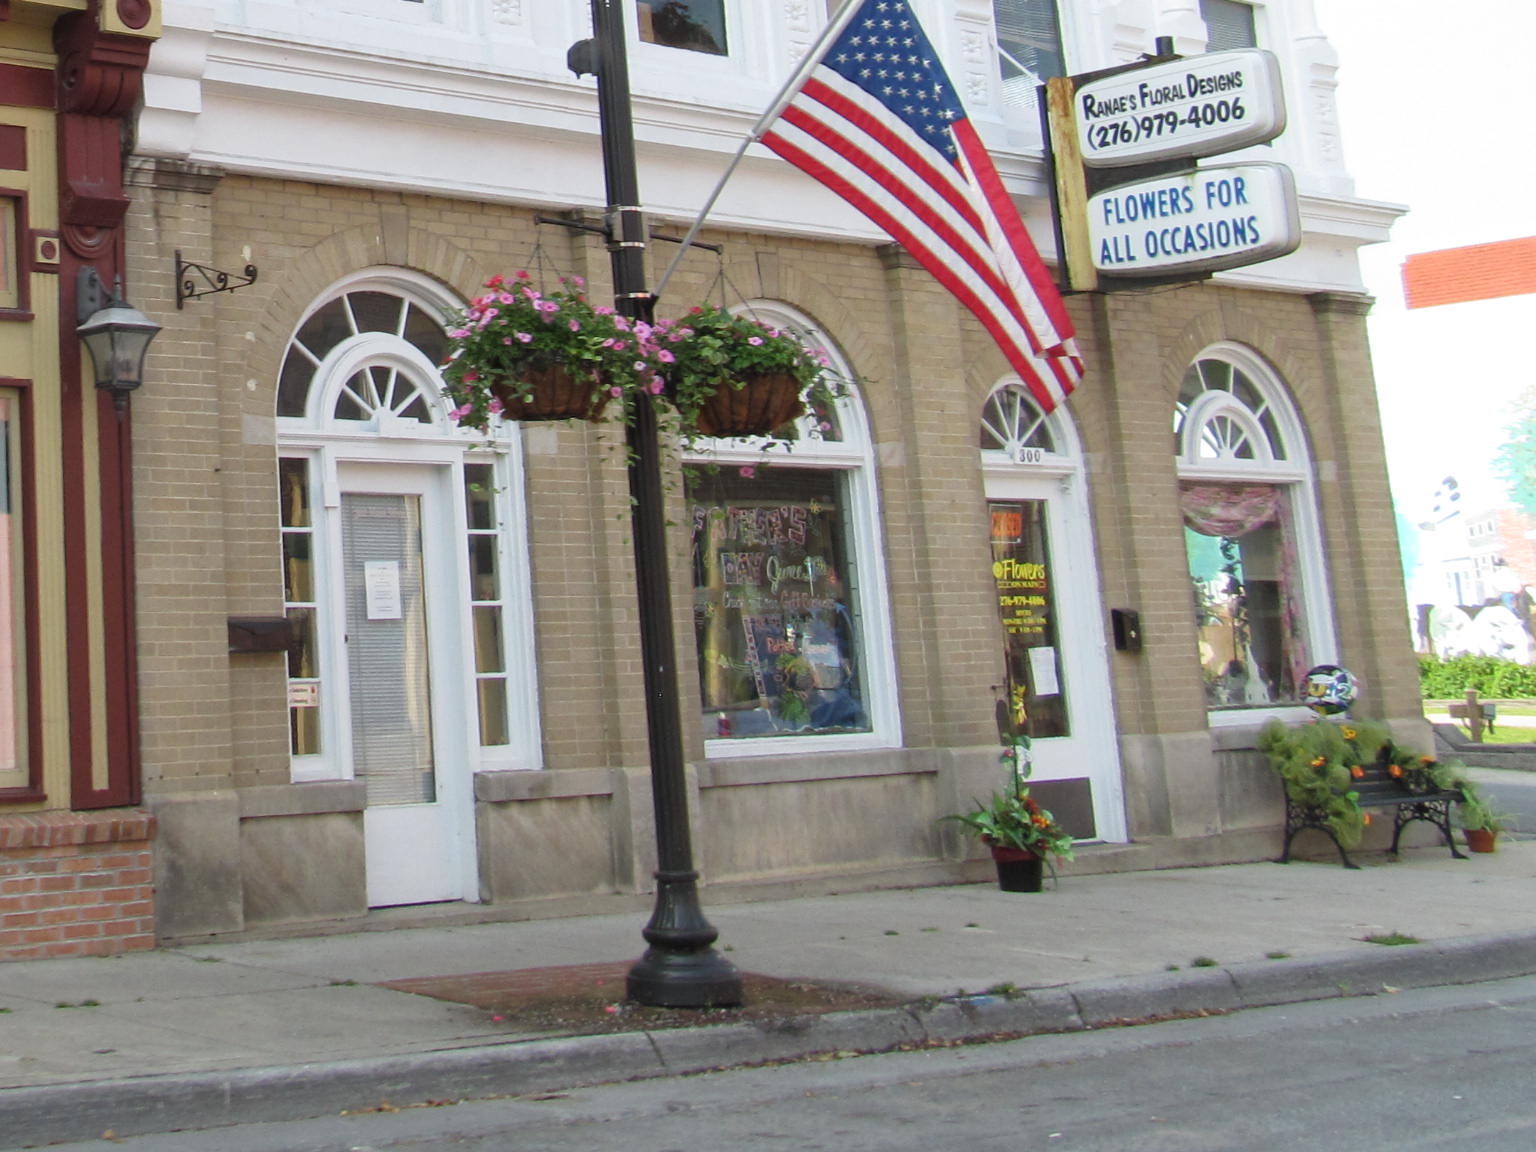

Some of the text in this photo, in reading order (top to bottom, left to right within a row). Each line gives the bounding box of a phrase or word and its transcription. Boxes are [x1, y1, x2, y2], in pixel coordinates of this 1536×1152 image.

[1138, 82, 1186, 108] FLORAL
[1186, 70, 1243, 98] DESIGNS
[1103, 176, 1248, 225] FLOWERS FOR
[1100, 215, 1260, 266] ALL OCCASIONS
[1019, 448, 1041, 463] 300
[1001, 559, 1046, 581] Flowers
